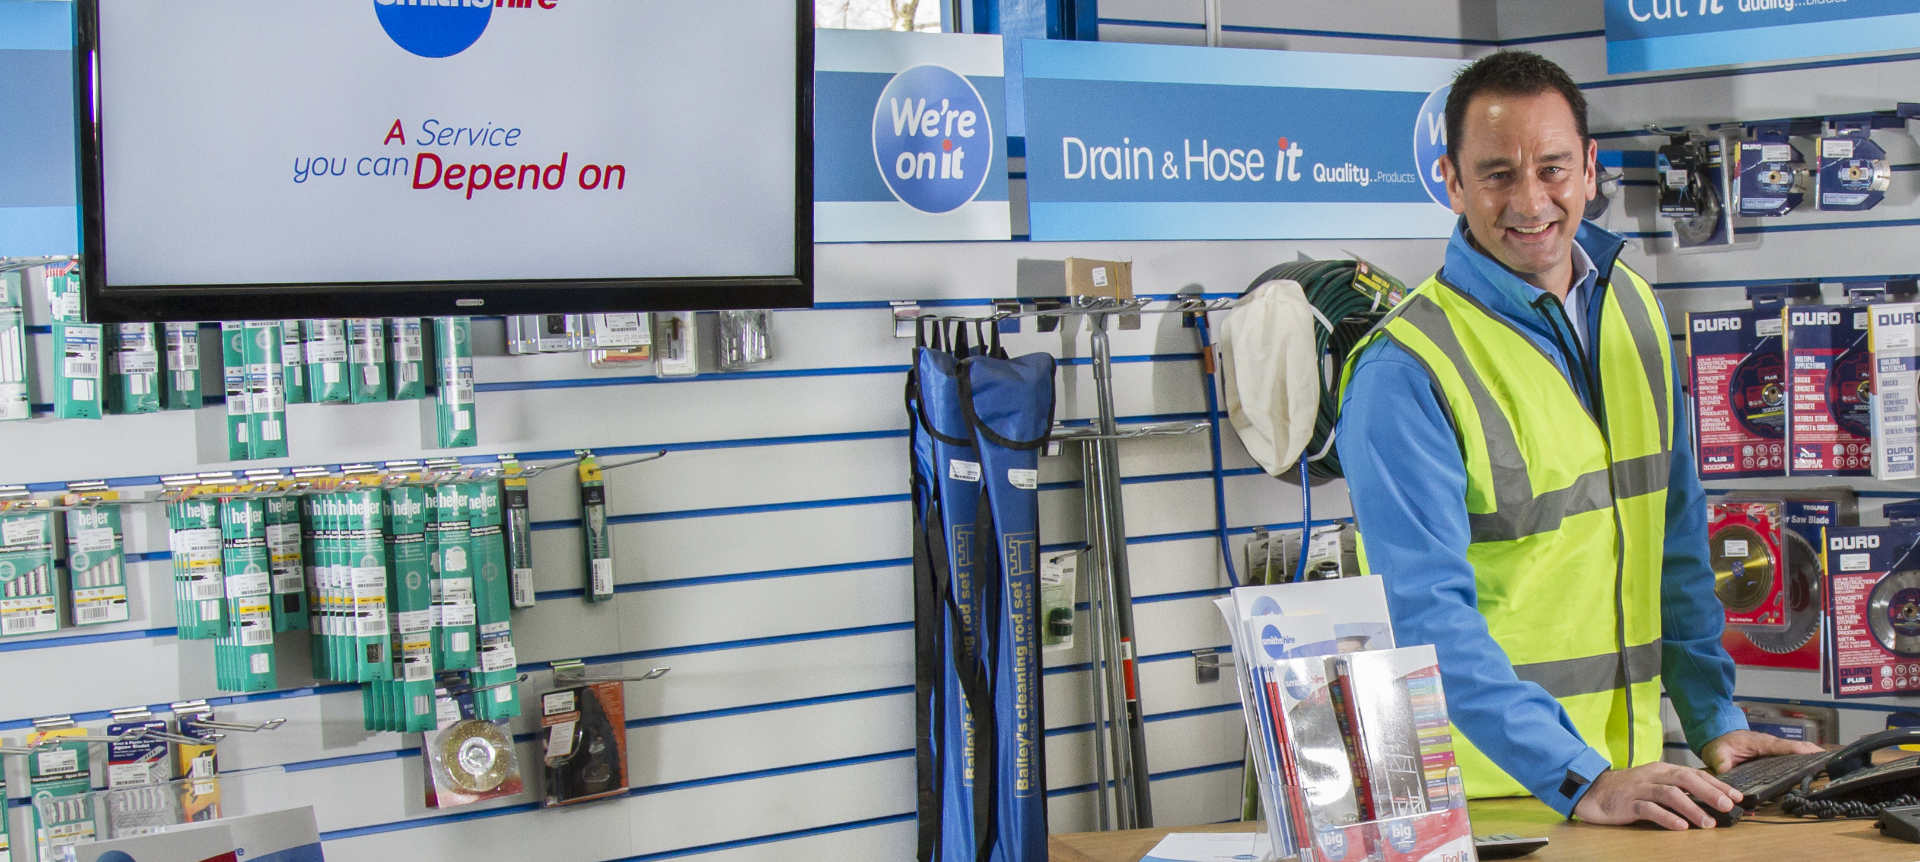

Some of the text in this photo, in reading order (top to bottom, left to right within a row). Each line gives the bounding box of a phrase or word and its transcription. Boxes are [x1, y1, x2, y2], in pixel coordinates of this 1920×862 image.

[890, 97, 977, 138] We're
[384, 118, 521, 147] A Service
[895, 138, 965, 180] on it
[1062, 136, 1154, 180] Drain
[1161, 151, 1180, 179] &
[1184, 138, 1265, 181] Hose
[1275, 136, 1303, 182] it
[293, 151, 626, 200] you can Depend on
[1693, 317, 1742, 332] DURO
[1792, 312, 1841, 326] DURO
[1703, 446, 1734, 455] DURO
[1887, 446, 1914, 455] DURO
[268, 498, 296, 515] heller
[349, 499, 380, 518] heller
[393, 499, 421, 518] heller
[439, 491, 468, 511] heller
[78, 509, 109, 528] heller
[187, 502, 216, 522] heller
[231, 502, 263, 527] heller
[1791, 515, 1807, 524] Saw
[1808, 515, 1829, 524] Blade
[1830, 534, 1880, 551] DURO
[958, 571, 970, 599] set
[959, 603, 972, 633] rod
[1841, 667, 1872, 676] DURO
[1010, 580, 1030, 791] Bailey's cleaning rod set
[1324, 830, 1344, 847] big
[1392, 824, 1412, 840] big
